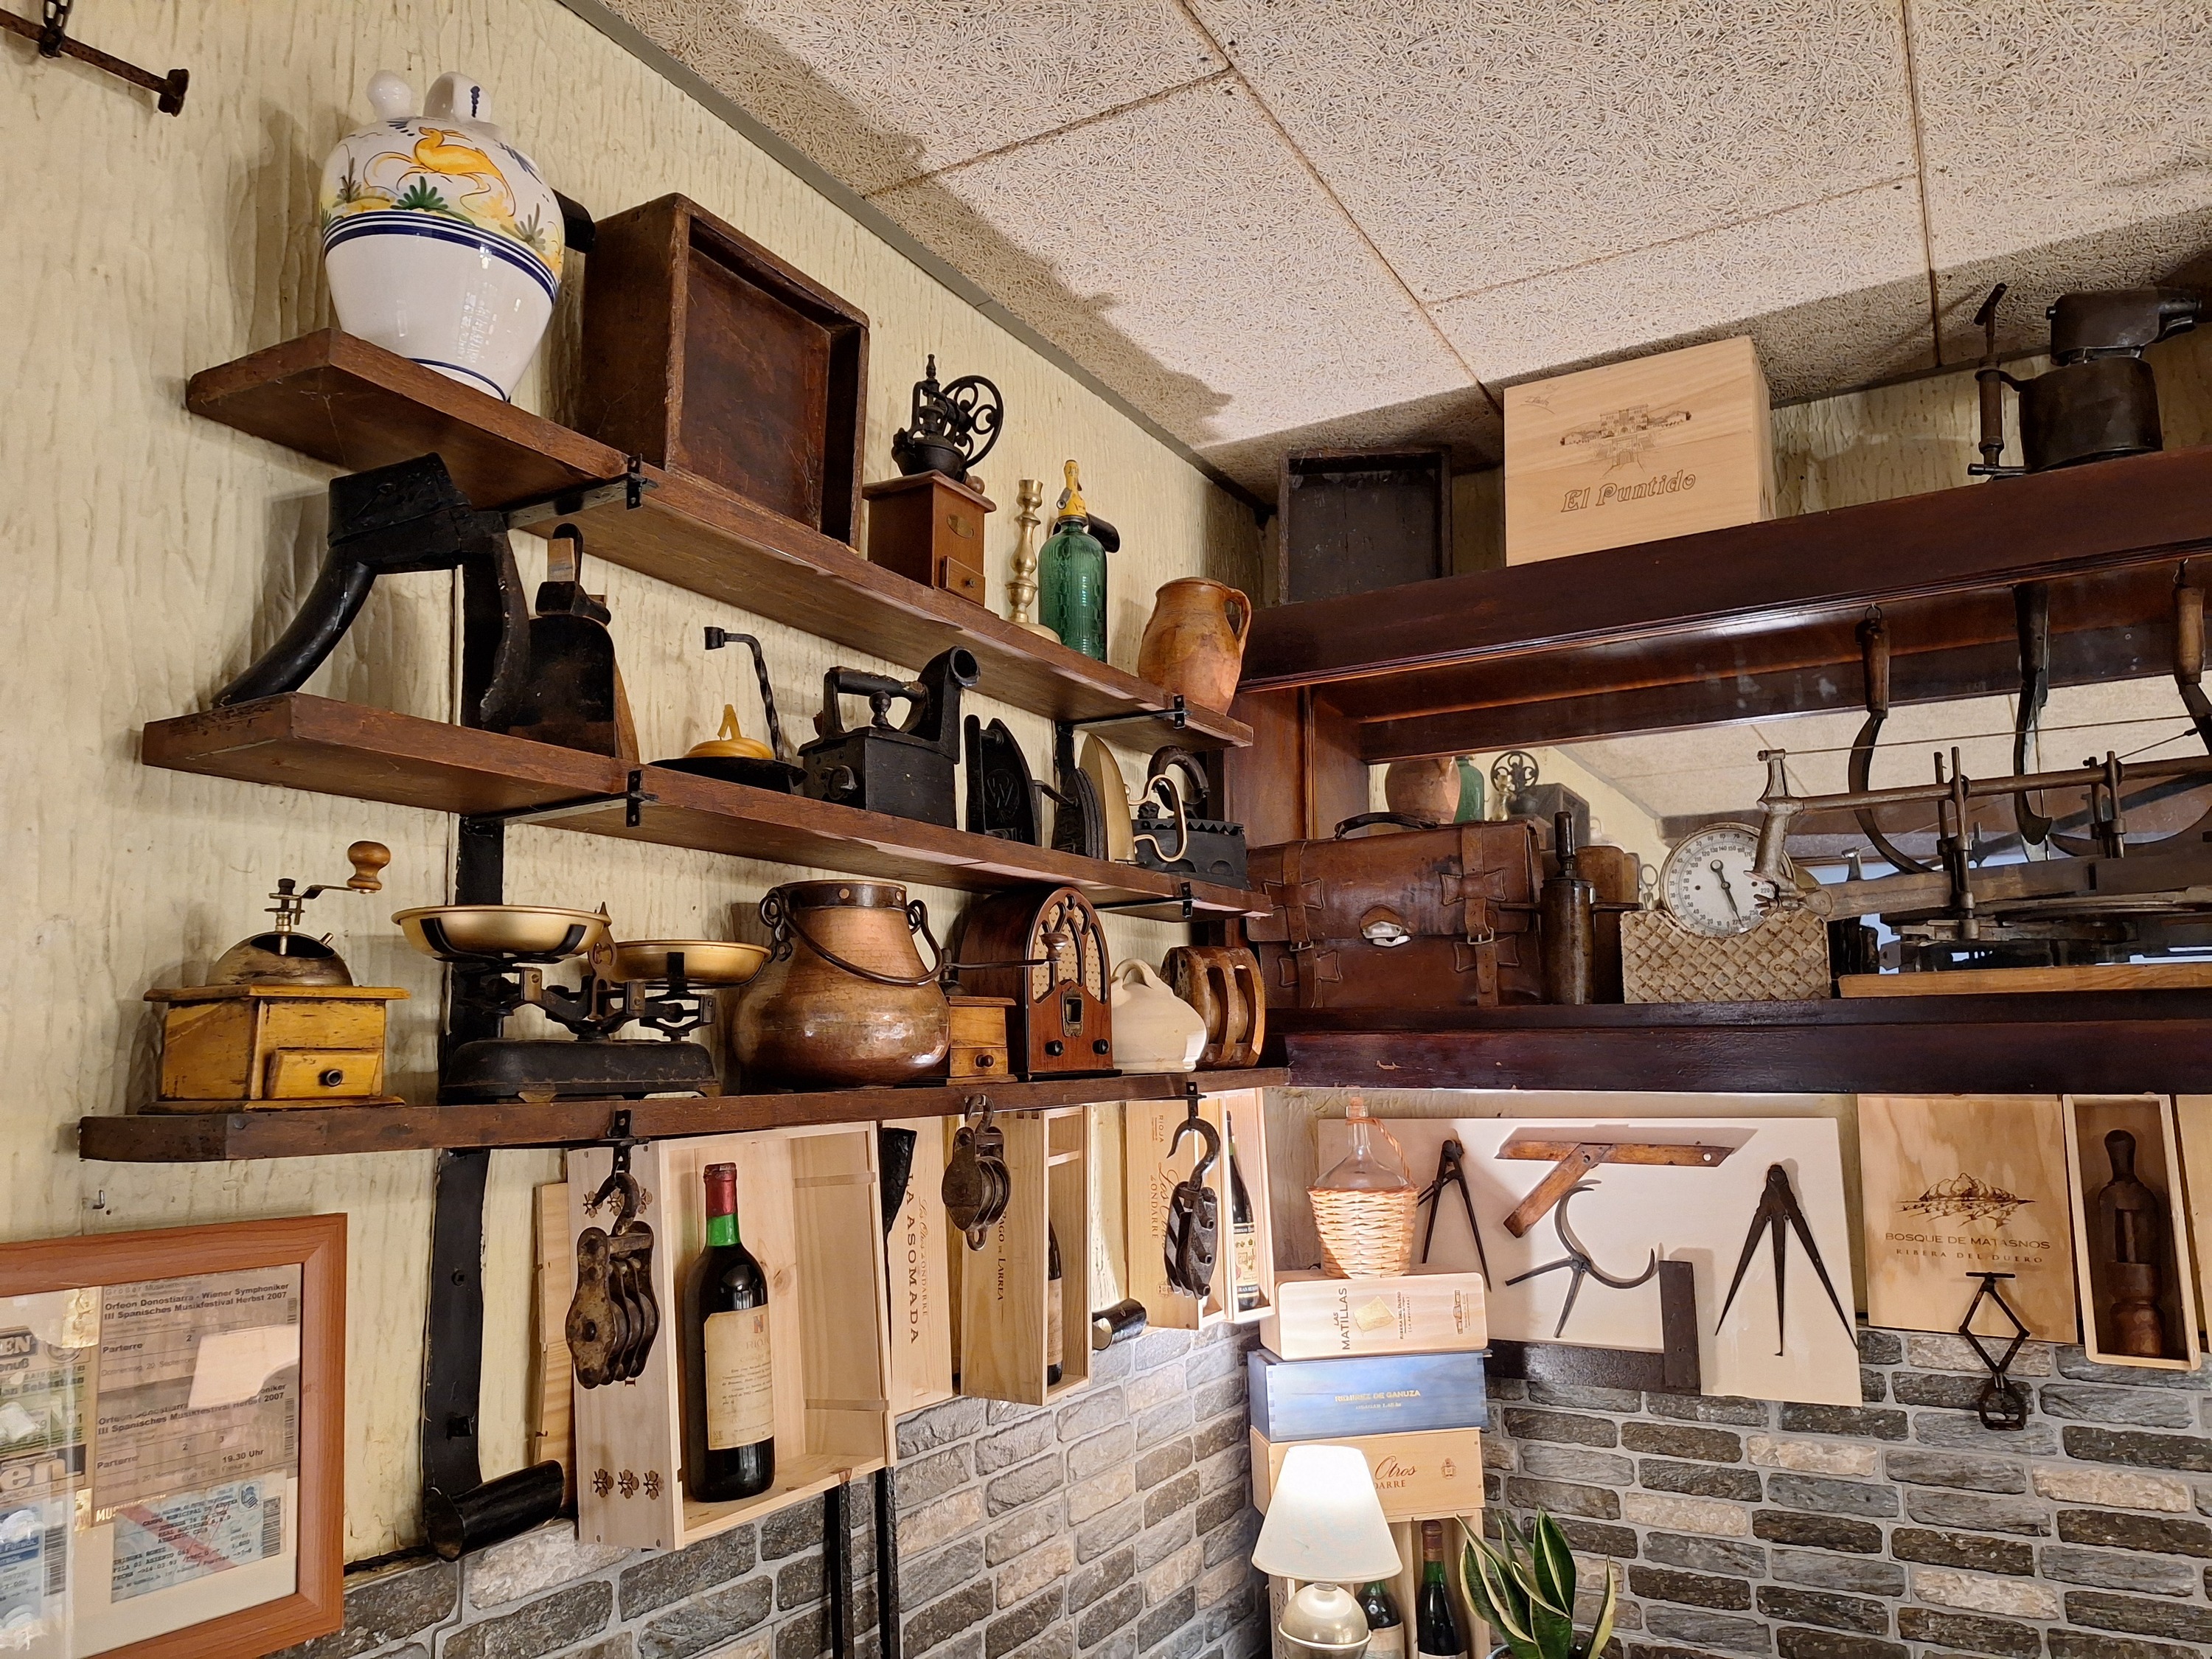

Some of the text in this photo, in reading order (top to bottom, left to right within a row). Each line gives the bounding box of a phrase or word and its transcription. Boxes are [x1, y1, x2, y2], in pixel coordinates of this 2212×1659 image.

[1560, 469, 1697, 513] El Puntido
[1885, 1232, 2051, 1250] BOSQUE DE MATASNOS
[1896, 1248, 2043, 1263] RIBERA DEL DUERO
[907, 1214, 919, 1344] ASOMADA
[998, 1258, 1006, 1301] LARREA
[103, 1291, 288, 1321] III Spanisches Musikfestival Herbst 2007
[105, 1301, 138, 1311] Orfeon
[140, 1295, 195, 1307] Donostiarra
[201, 1290, 232, 1301] Wiener
[234, 1282, 290, 1296] Symphoniker
[1338, 1287, 1351, 1350] MATILLAS
[102, 1342, 144, 1354] Parterre
[1385, 1389, 1422, 1399] GANUZA
[111, 1416, 167, 1433] Spanisches
[263, 1392, 285, 1403] 2007
[182, 1443, 189, 1451] 2
[222, 1448, 265, 1464] 19.30 Uhr
[1374, 1455, 1418, 1481] Otros
[1374, 1479, 1406, 1490] DARRE
